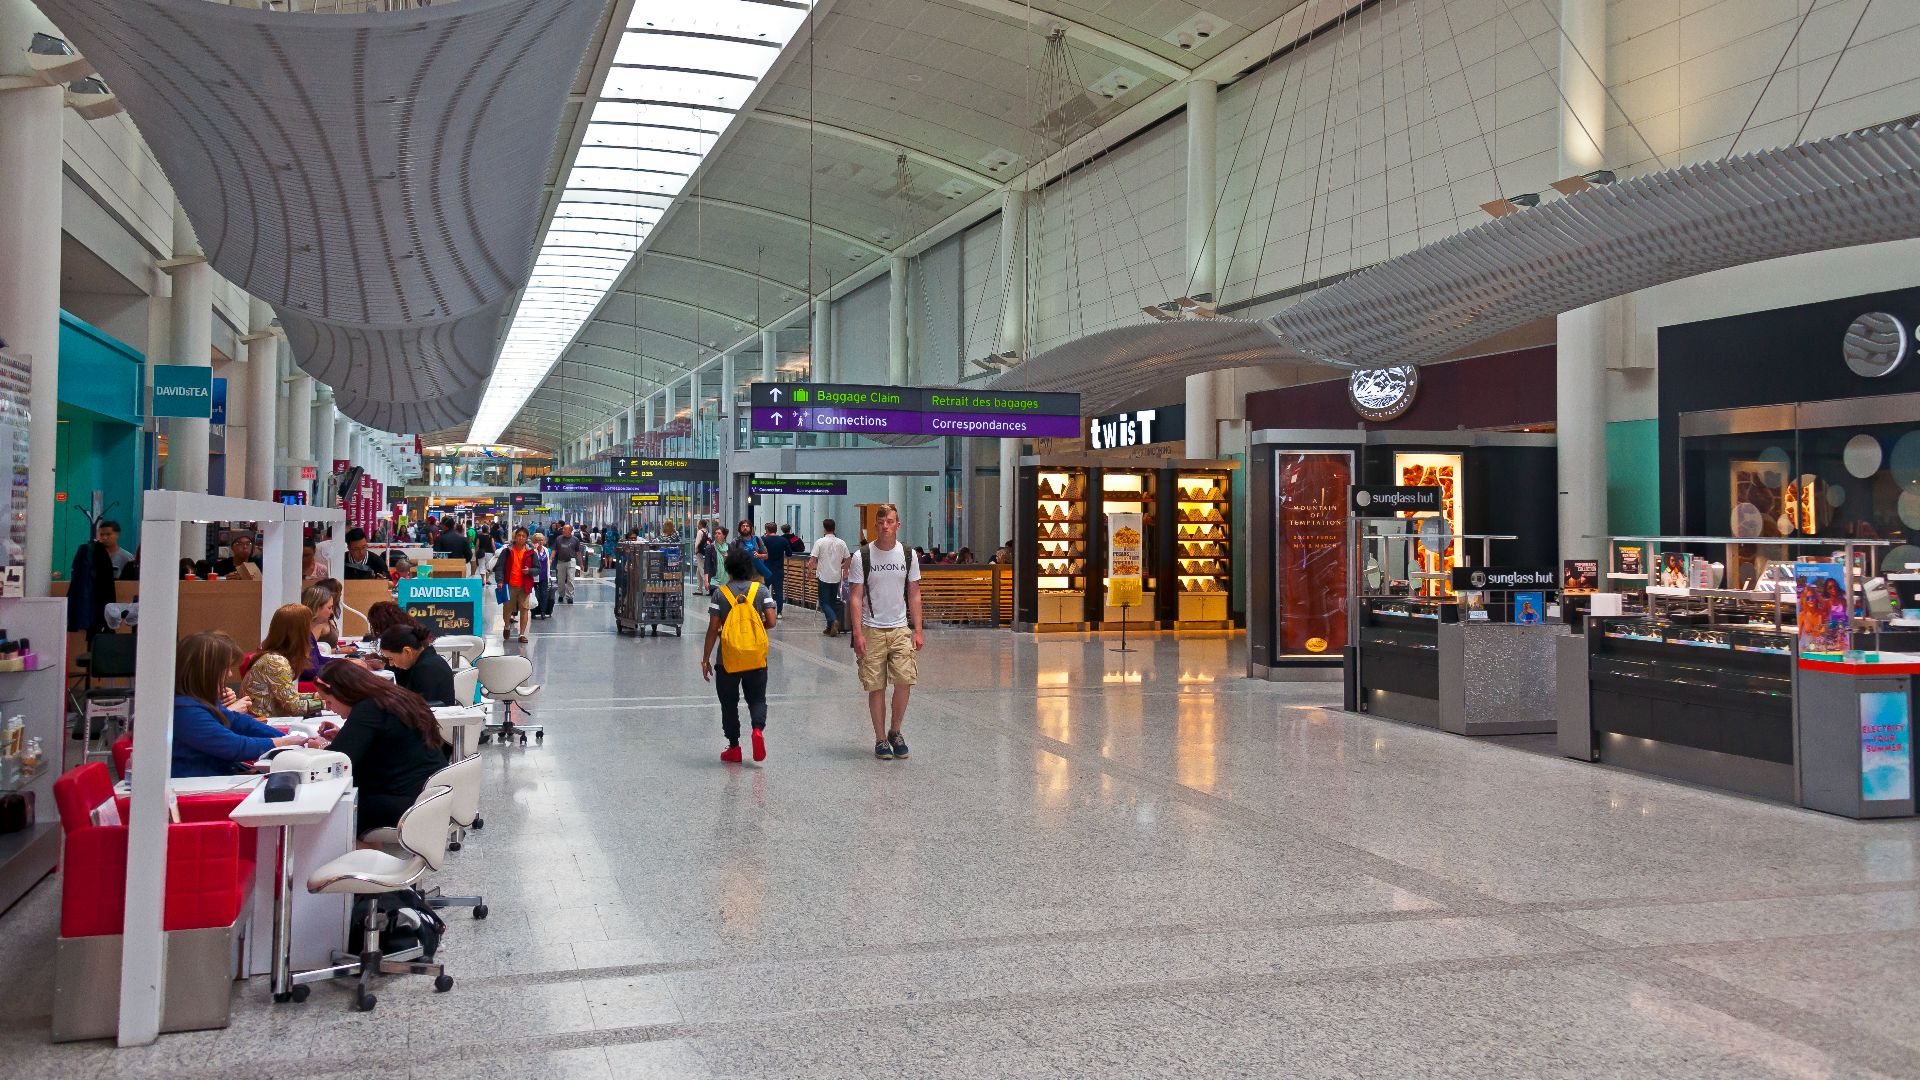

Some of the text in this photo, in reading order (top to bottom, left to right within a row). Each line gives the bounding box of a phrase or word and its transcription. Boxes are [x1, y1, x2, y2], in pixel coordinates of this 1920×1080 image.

[817, 390, 1039, 410] Baggage Claim Retrait des bagages
[817, 414, 1027, 432] Connections Correspondances
[1372, 491, 1434, 506] sunglass hut
[870, 563, 899, 572] NIXON
[1488, 571, 1554, 587] sunglass hut
[410, 586, 470, 598] DAVIDsTEA
[1872, 734, 1895, 742] YOUR
